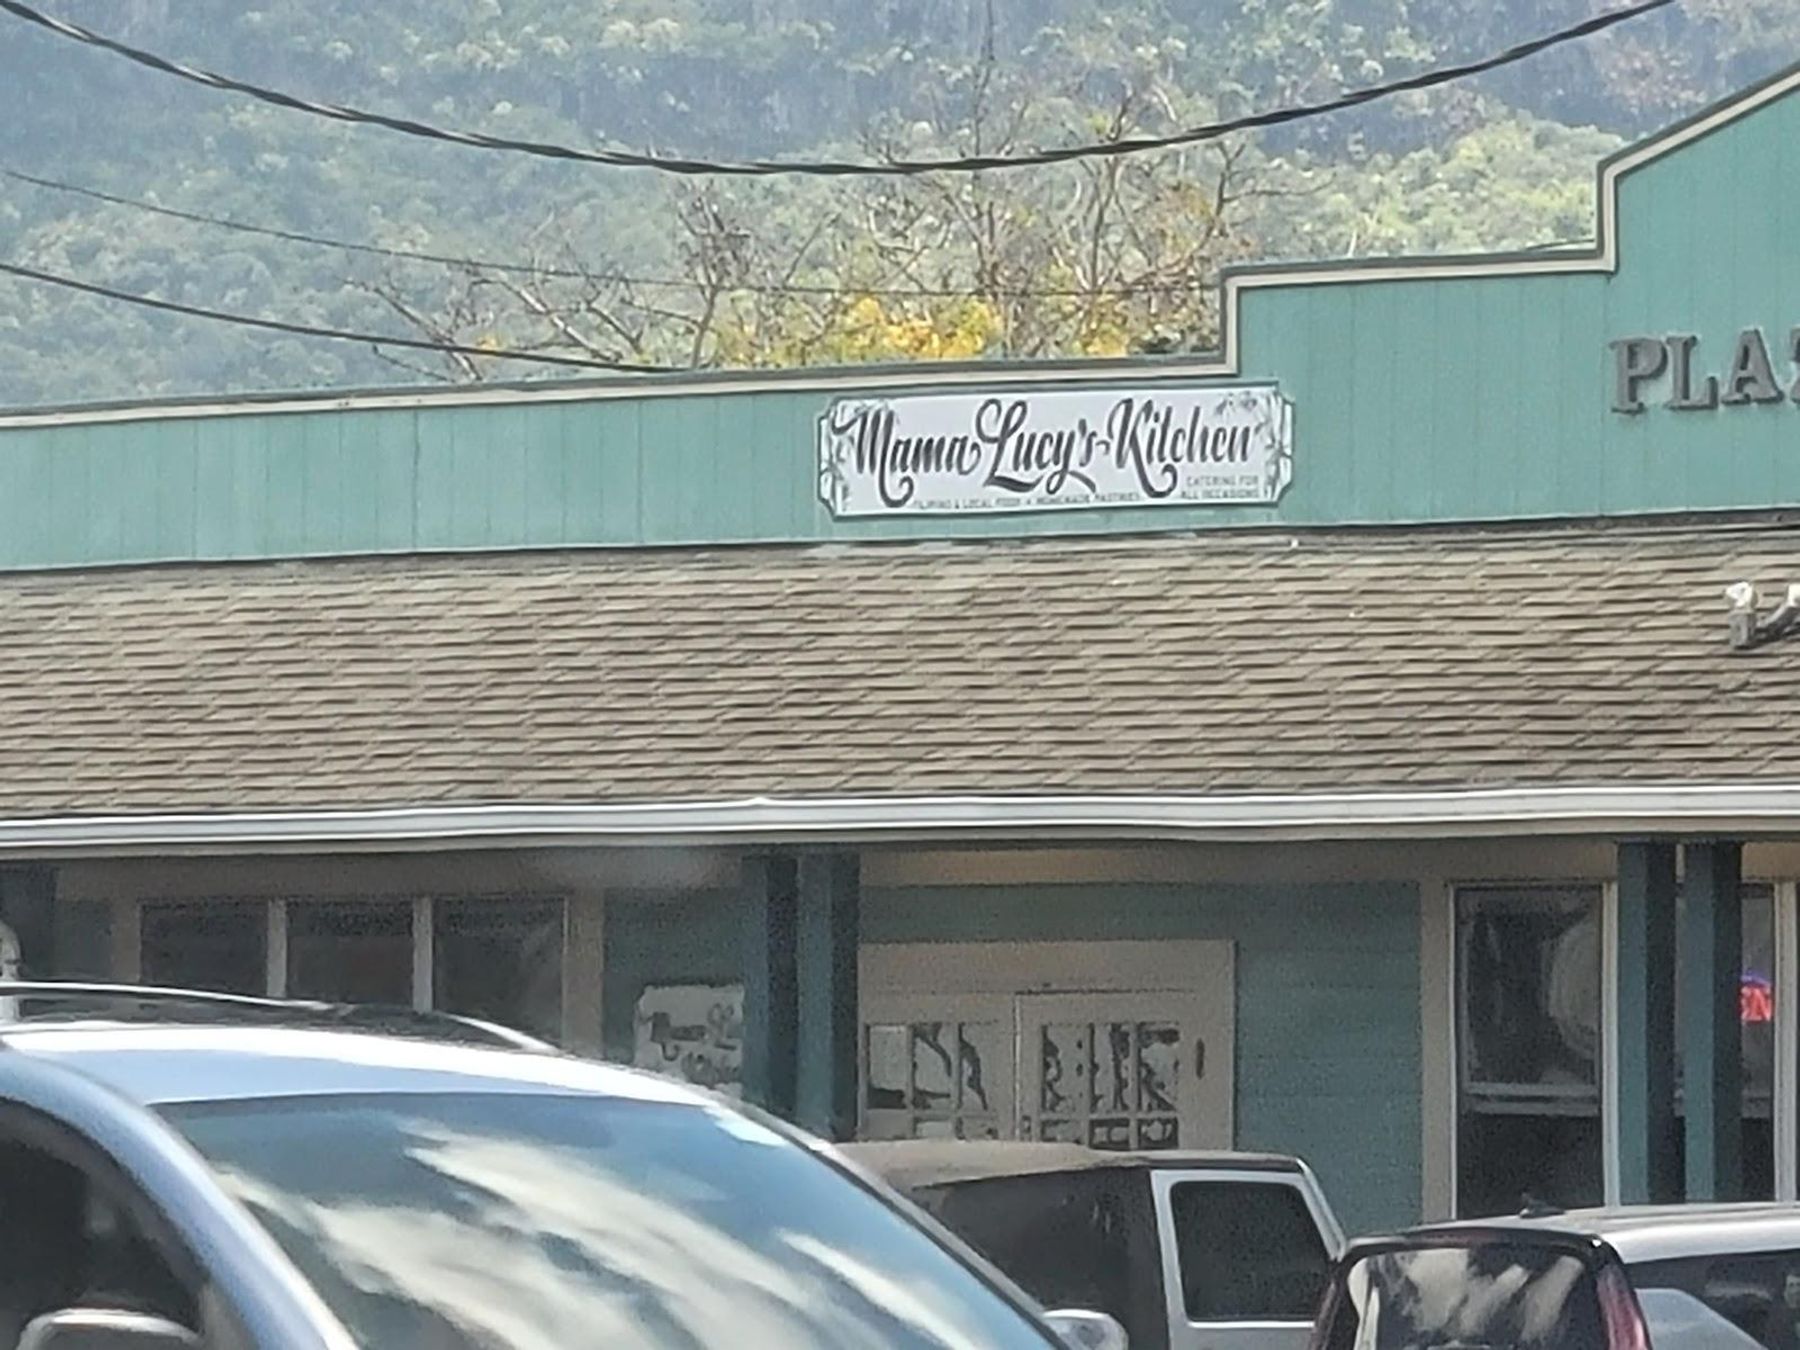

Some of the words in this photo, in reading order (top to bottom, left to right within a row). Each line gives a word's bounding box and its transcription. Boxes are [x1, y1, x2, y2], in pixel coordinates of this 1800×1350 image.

[1607, 324, 1800, 413] PLA
[831, 409, 982, 508] Mama
[976, 399, 1099, 495] Lucy's
[1107, 398, 1250, 498] Kitchen
[1186, 475, 1236, 487] CATERING
[1240, 474, 1259, 485] FOR
[1181, 489, 1199, 500] ALL
[1201, 488, 1260, 499] OCCASIONS
[963, 498, 993, 509] LOCAL
